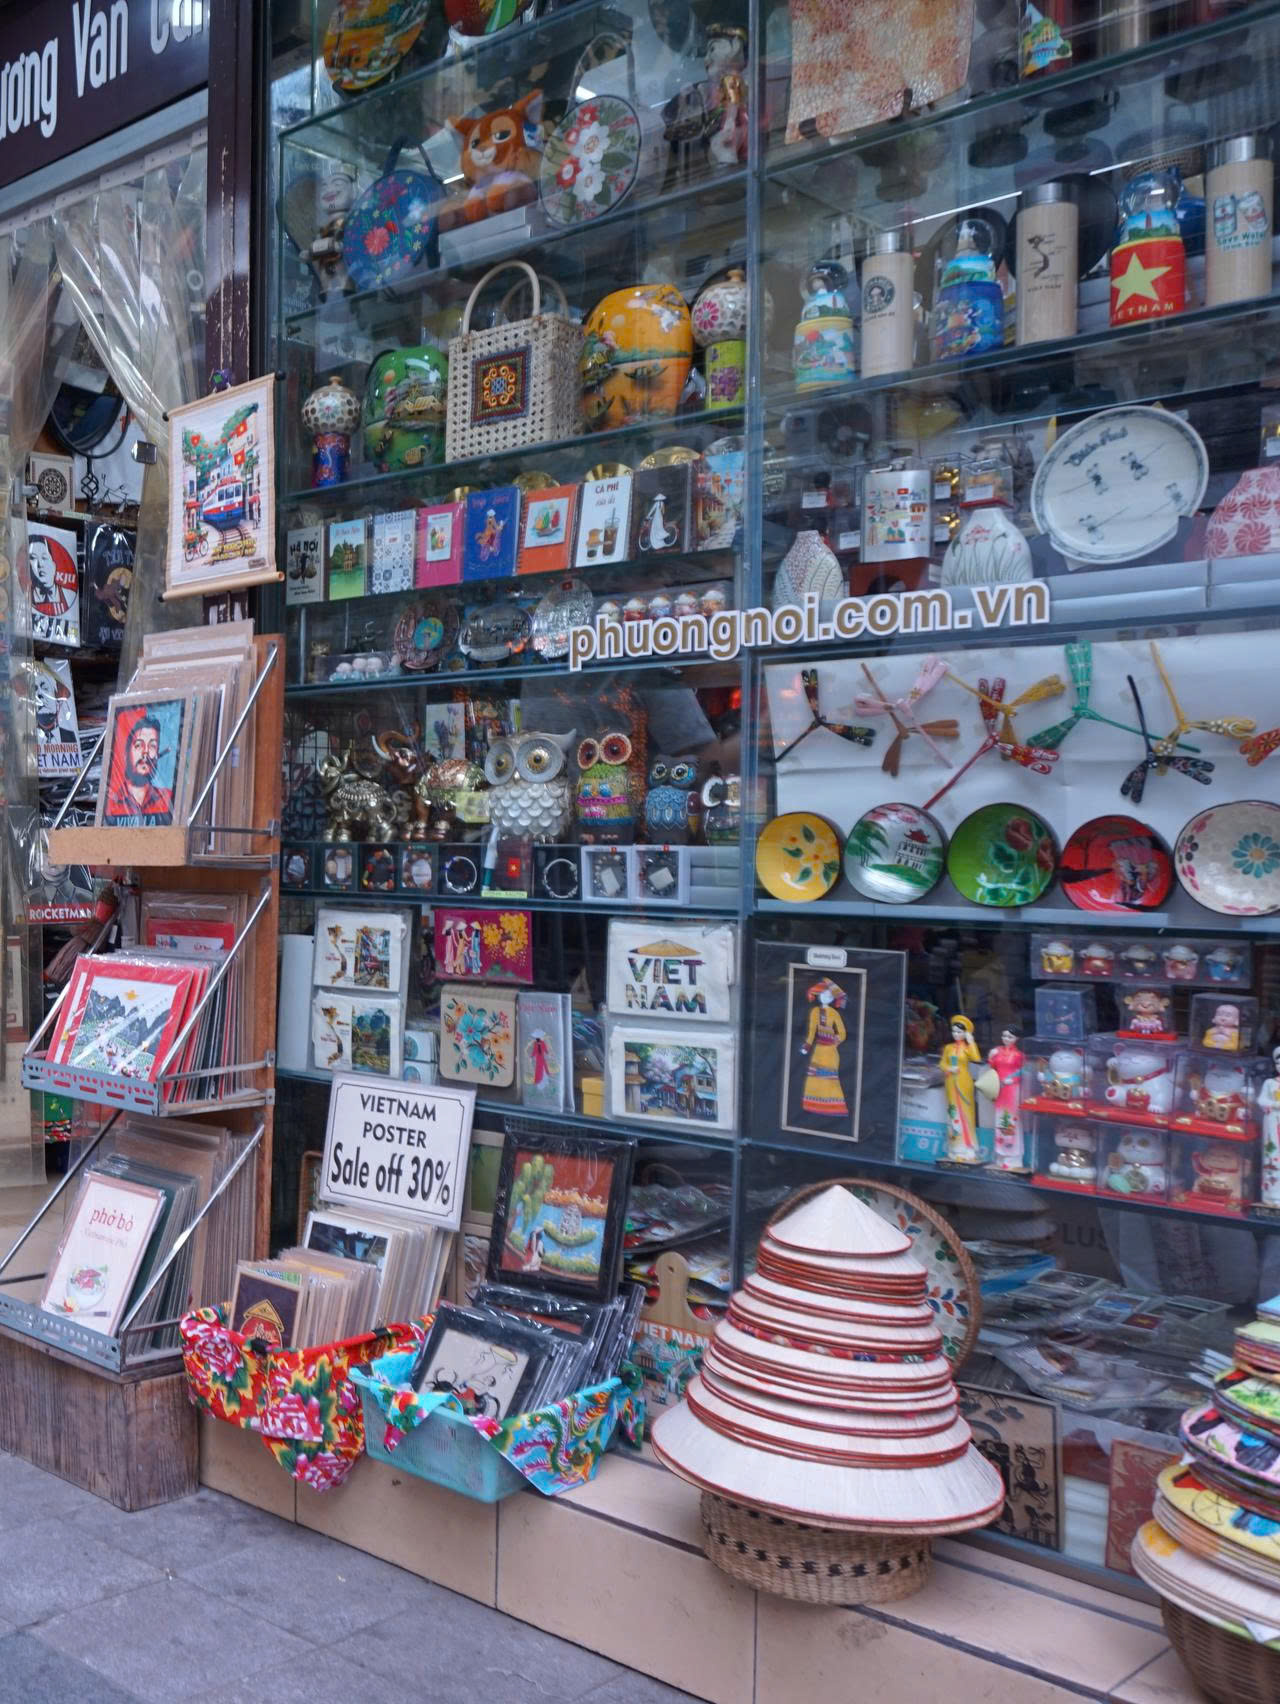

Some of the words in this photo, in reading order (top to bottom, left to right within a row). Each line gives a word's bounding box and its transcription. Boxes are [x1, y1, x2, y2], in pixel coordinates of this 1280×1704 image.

[1112, 302, 1174, 321] ETNAM
[56, 572, 76, 584] KJU
[568, 577, 1052, 672] phuongnoi.com.vn
[51, 753, 81, 767] NAM
[141, 815, 157, 827] LA
[29, 907, 92, 920] ROCKETMAN
[627, 957, 707, 986] VIET
[624, 983, 708, 1014] NAM
[360, 1093, 437, 1122] VIETNAM
[362, 1121, 428, 1149] POSTER
[331, 1142, 370, 1189] Sale
[375, 1152, 405, 1195] off
[407, 1155, 451, 1206] 30%
[671, 1328, 710, 1349] NAM
